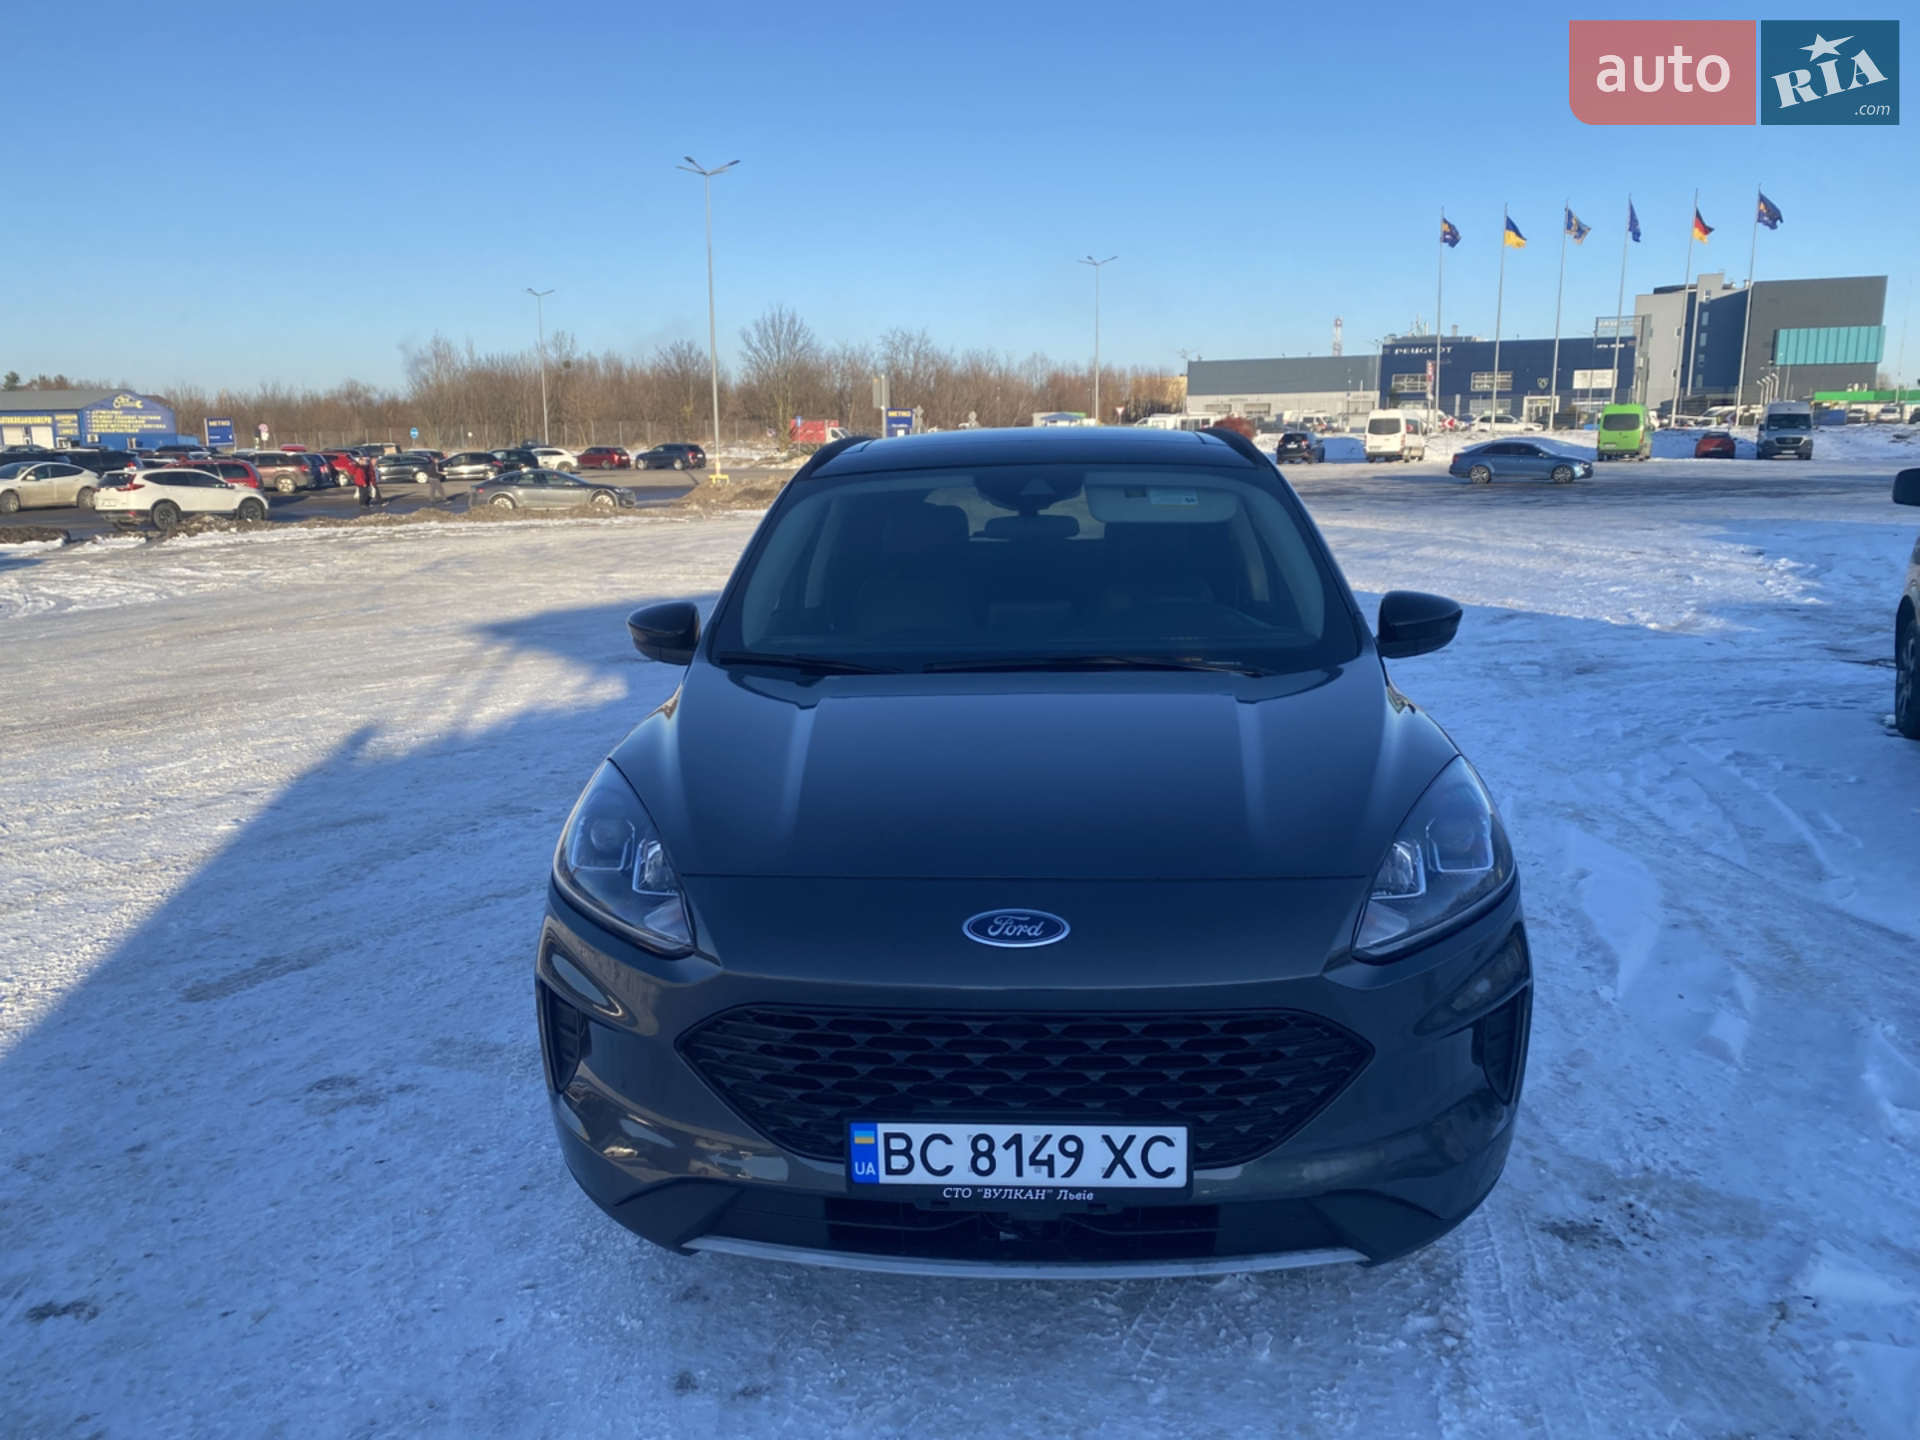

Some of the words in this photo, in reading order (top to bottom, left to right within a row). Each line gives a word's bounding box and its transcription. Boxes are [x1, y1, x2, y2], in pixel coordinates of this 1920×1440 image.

[987, 915, 1045, 937] Ford
[970, 1133, 1085, 1178] 8149
[854, 1162, 876, 1175] UA
[943, 1187, 972, 1199] СТО
[1056, 1189, 1094, 1201] Львів
